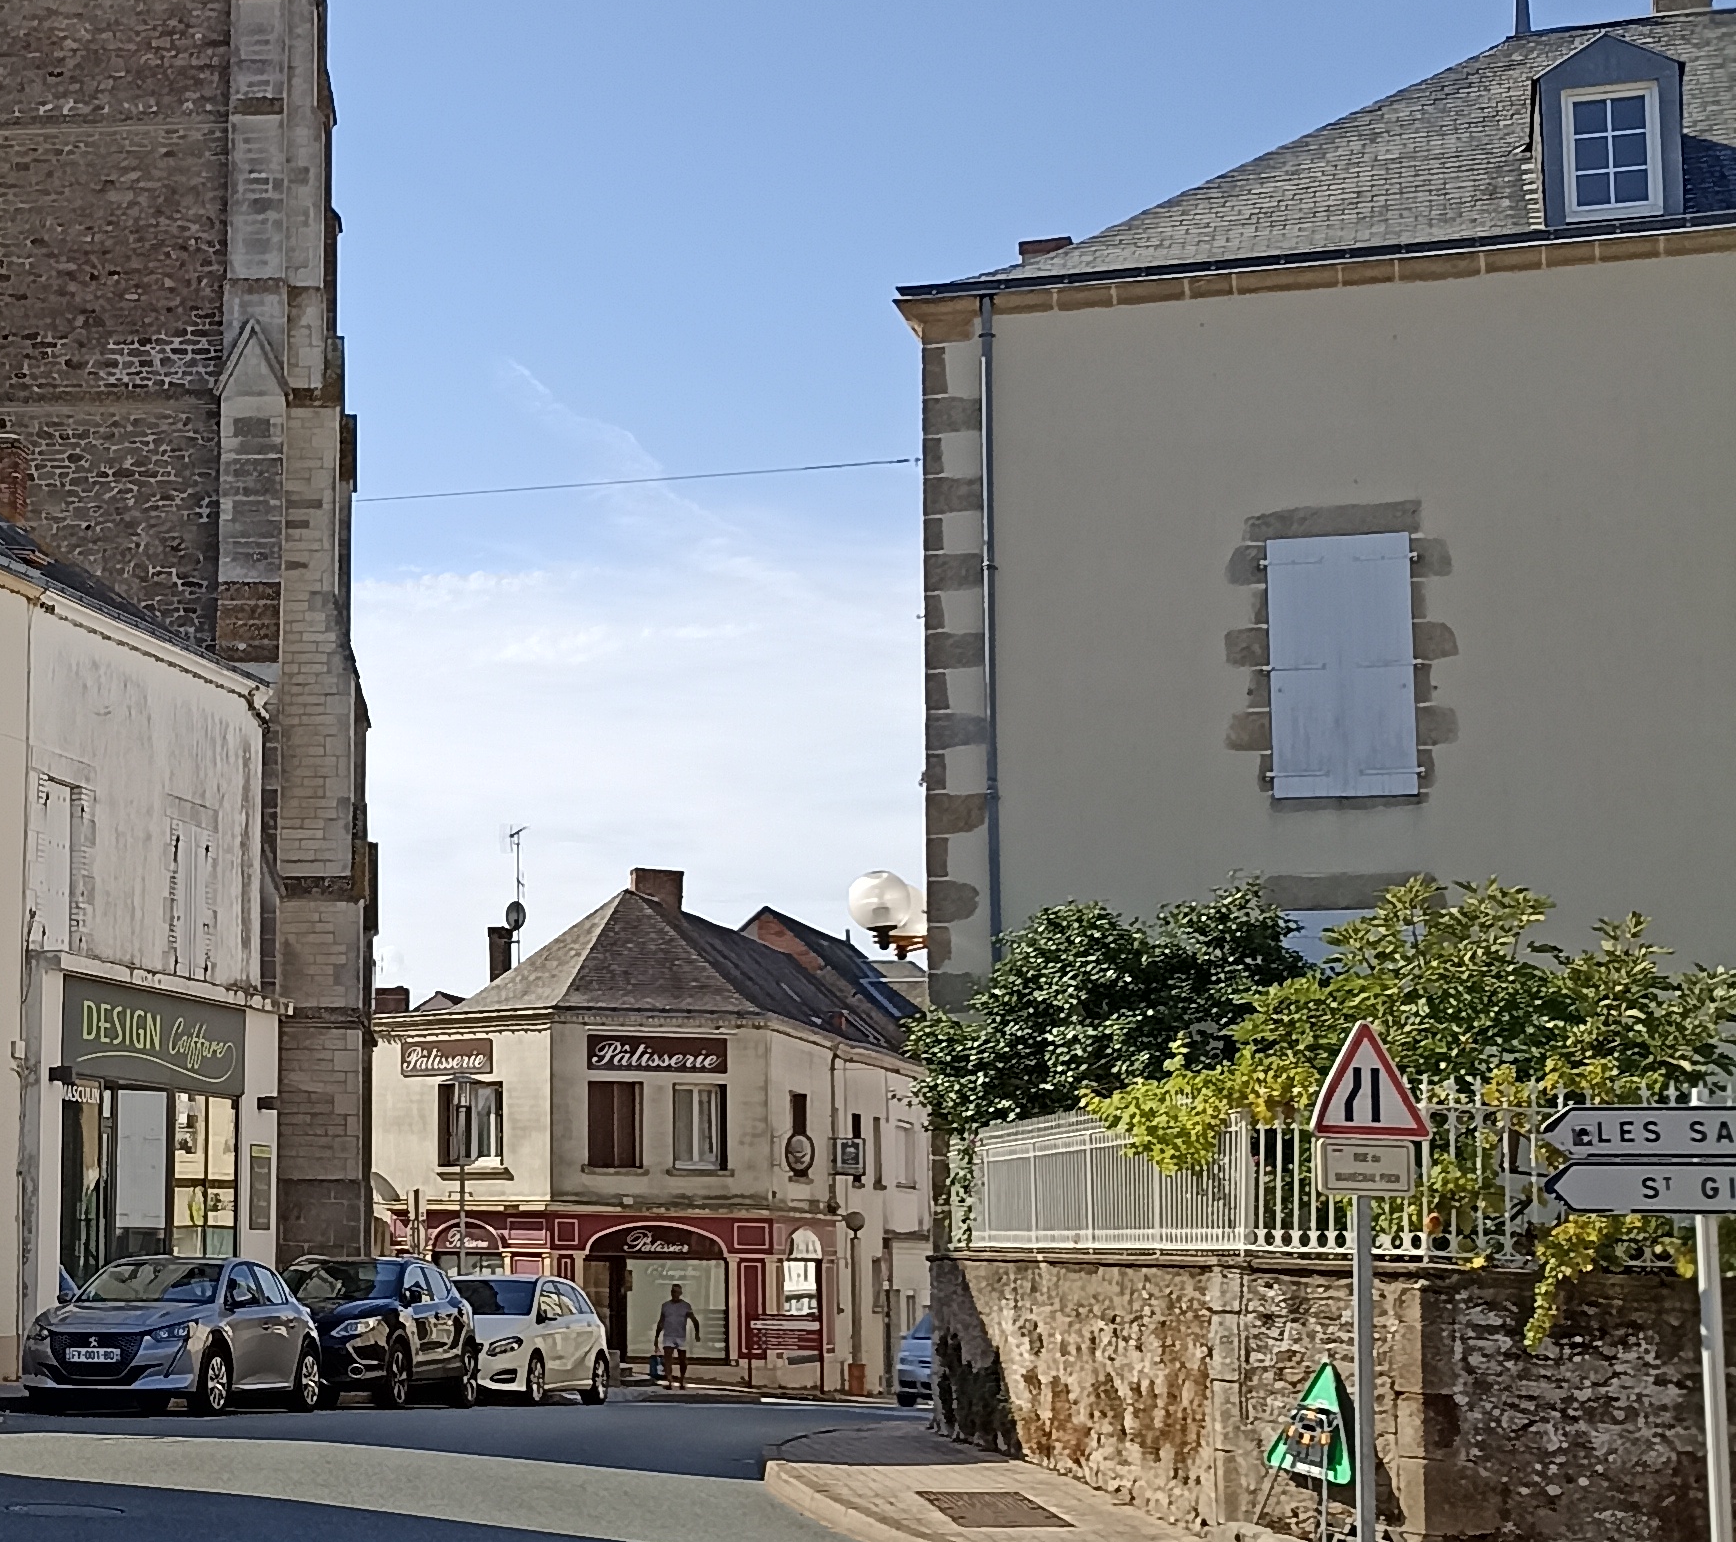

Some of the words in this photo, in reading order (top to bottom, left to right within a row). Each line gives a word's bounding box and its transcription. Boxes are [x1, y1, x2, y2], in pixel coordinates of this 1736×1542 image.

[82, 1000, 161, 1051] DESIGN
[403, 1046, 488, 1070] Pâtisserie
[591, 1041, 721, 1069] Pâtisserie
[1597, 1120, 1661, 1143] LES
[1689, 1120, 1735, 1143] SA
[1700, 1176, 1735, 1199] GI
